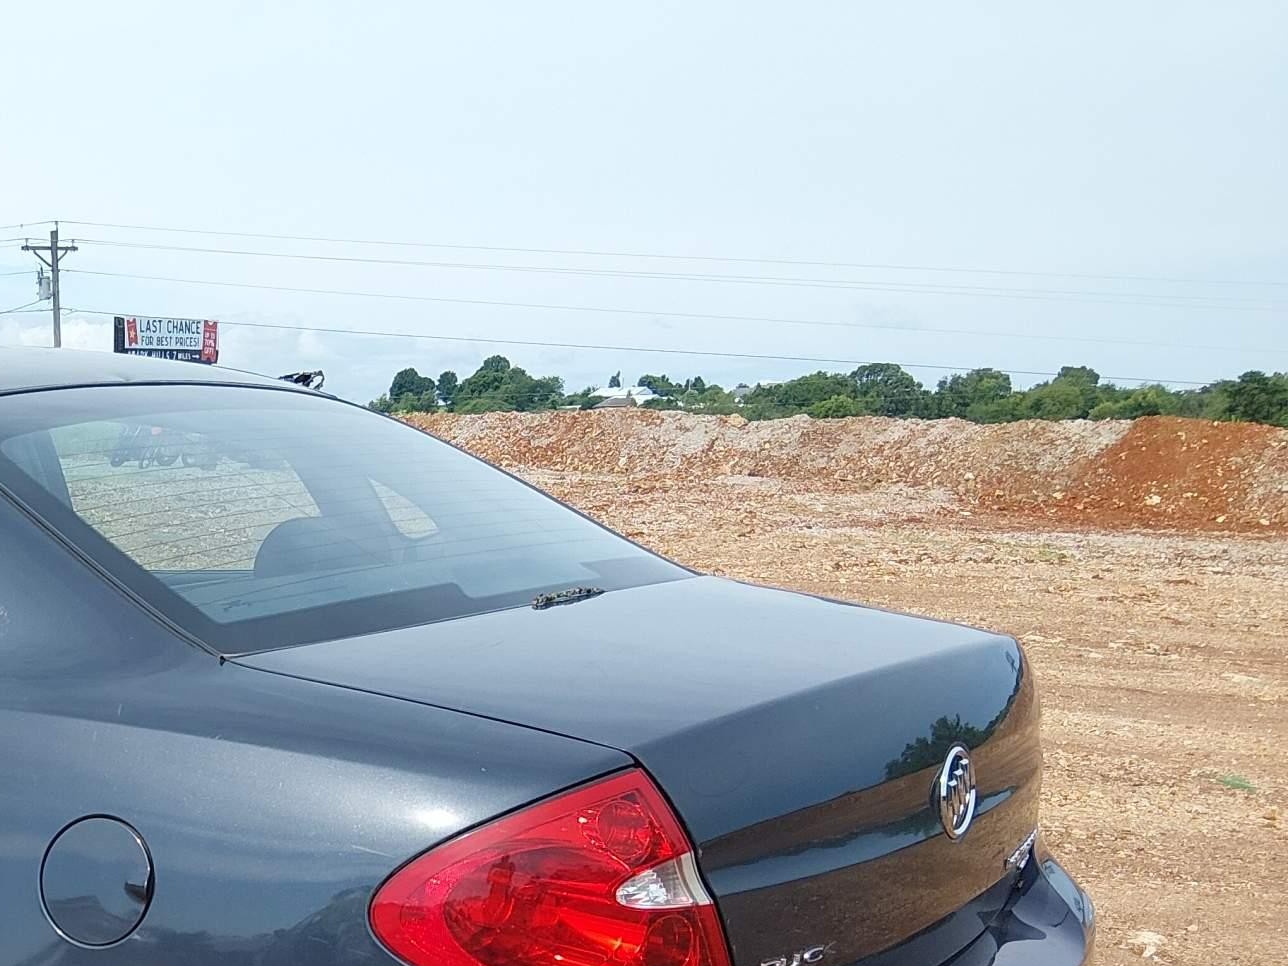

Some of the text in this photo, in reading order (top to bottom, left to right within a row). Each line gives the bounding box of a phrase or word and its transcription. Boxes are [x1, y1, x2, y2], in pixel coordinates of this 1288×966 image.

[139, 319, 201, 335] LAST CHANCE
[141, 335, 201, 348] FOR BEST PRICES!
[172, 350, 178, 361] 7
